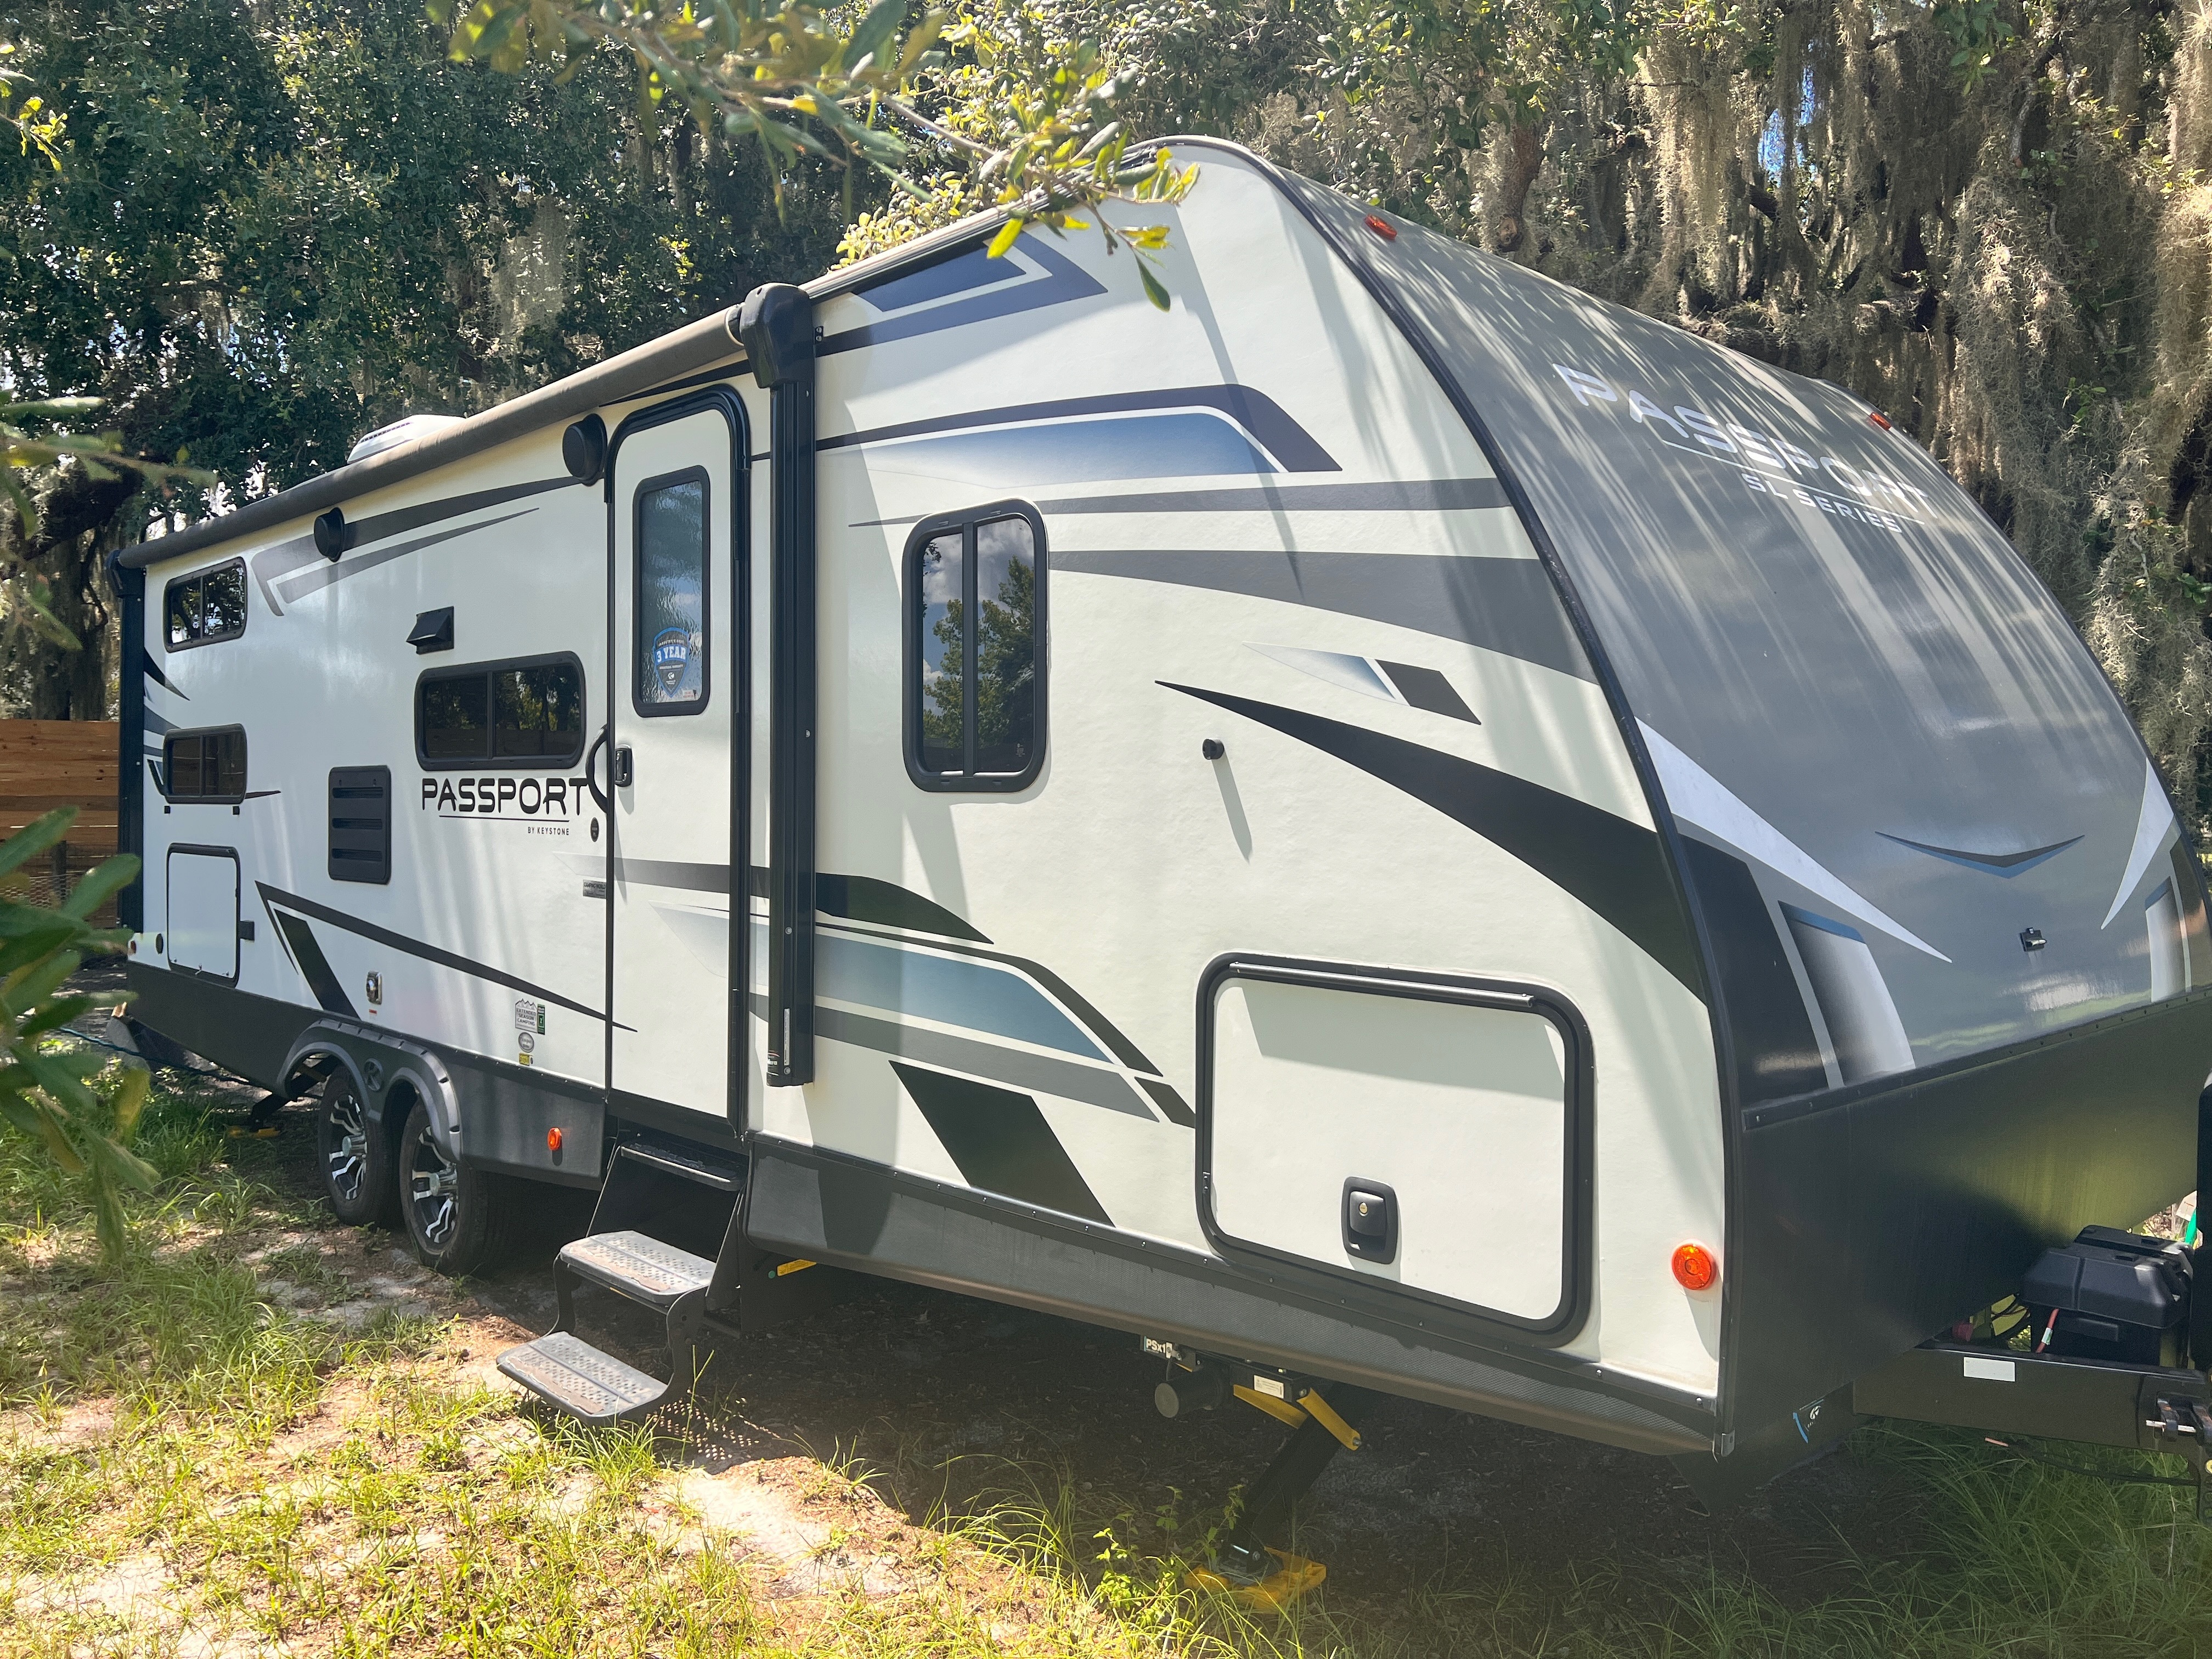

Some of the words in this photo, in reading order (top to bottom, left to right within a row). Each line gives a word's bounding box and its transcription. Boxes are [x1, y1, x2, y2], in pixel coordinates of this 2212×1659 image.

[1552, 363, 1938, 518] PASSPORT
[1741, 473, 1788, 500] SL
[1792, 488, 1903, 534] SERIES
[657, 651, 662, 663] 3
[664, 646, 686, 660] YEAR
[422, 778, 588, 816] PASSPORT
[537, 827, 569, 836] KEYSTONE
[1146, 1338, 1166, 1353] PSx1
